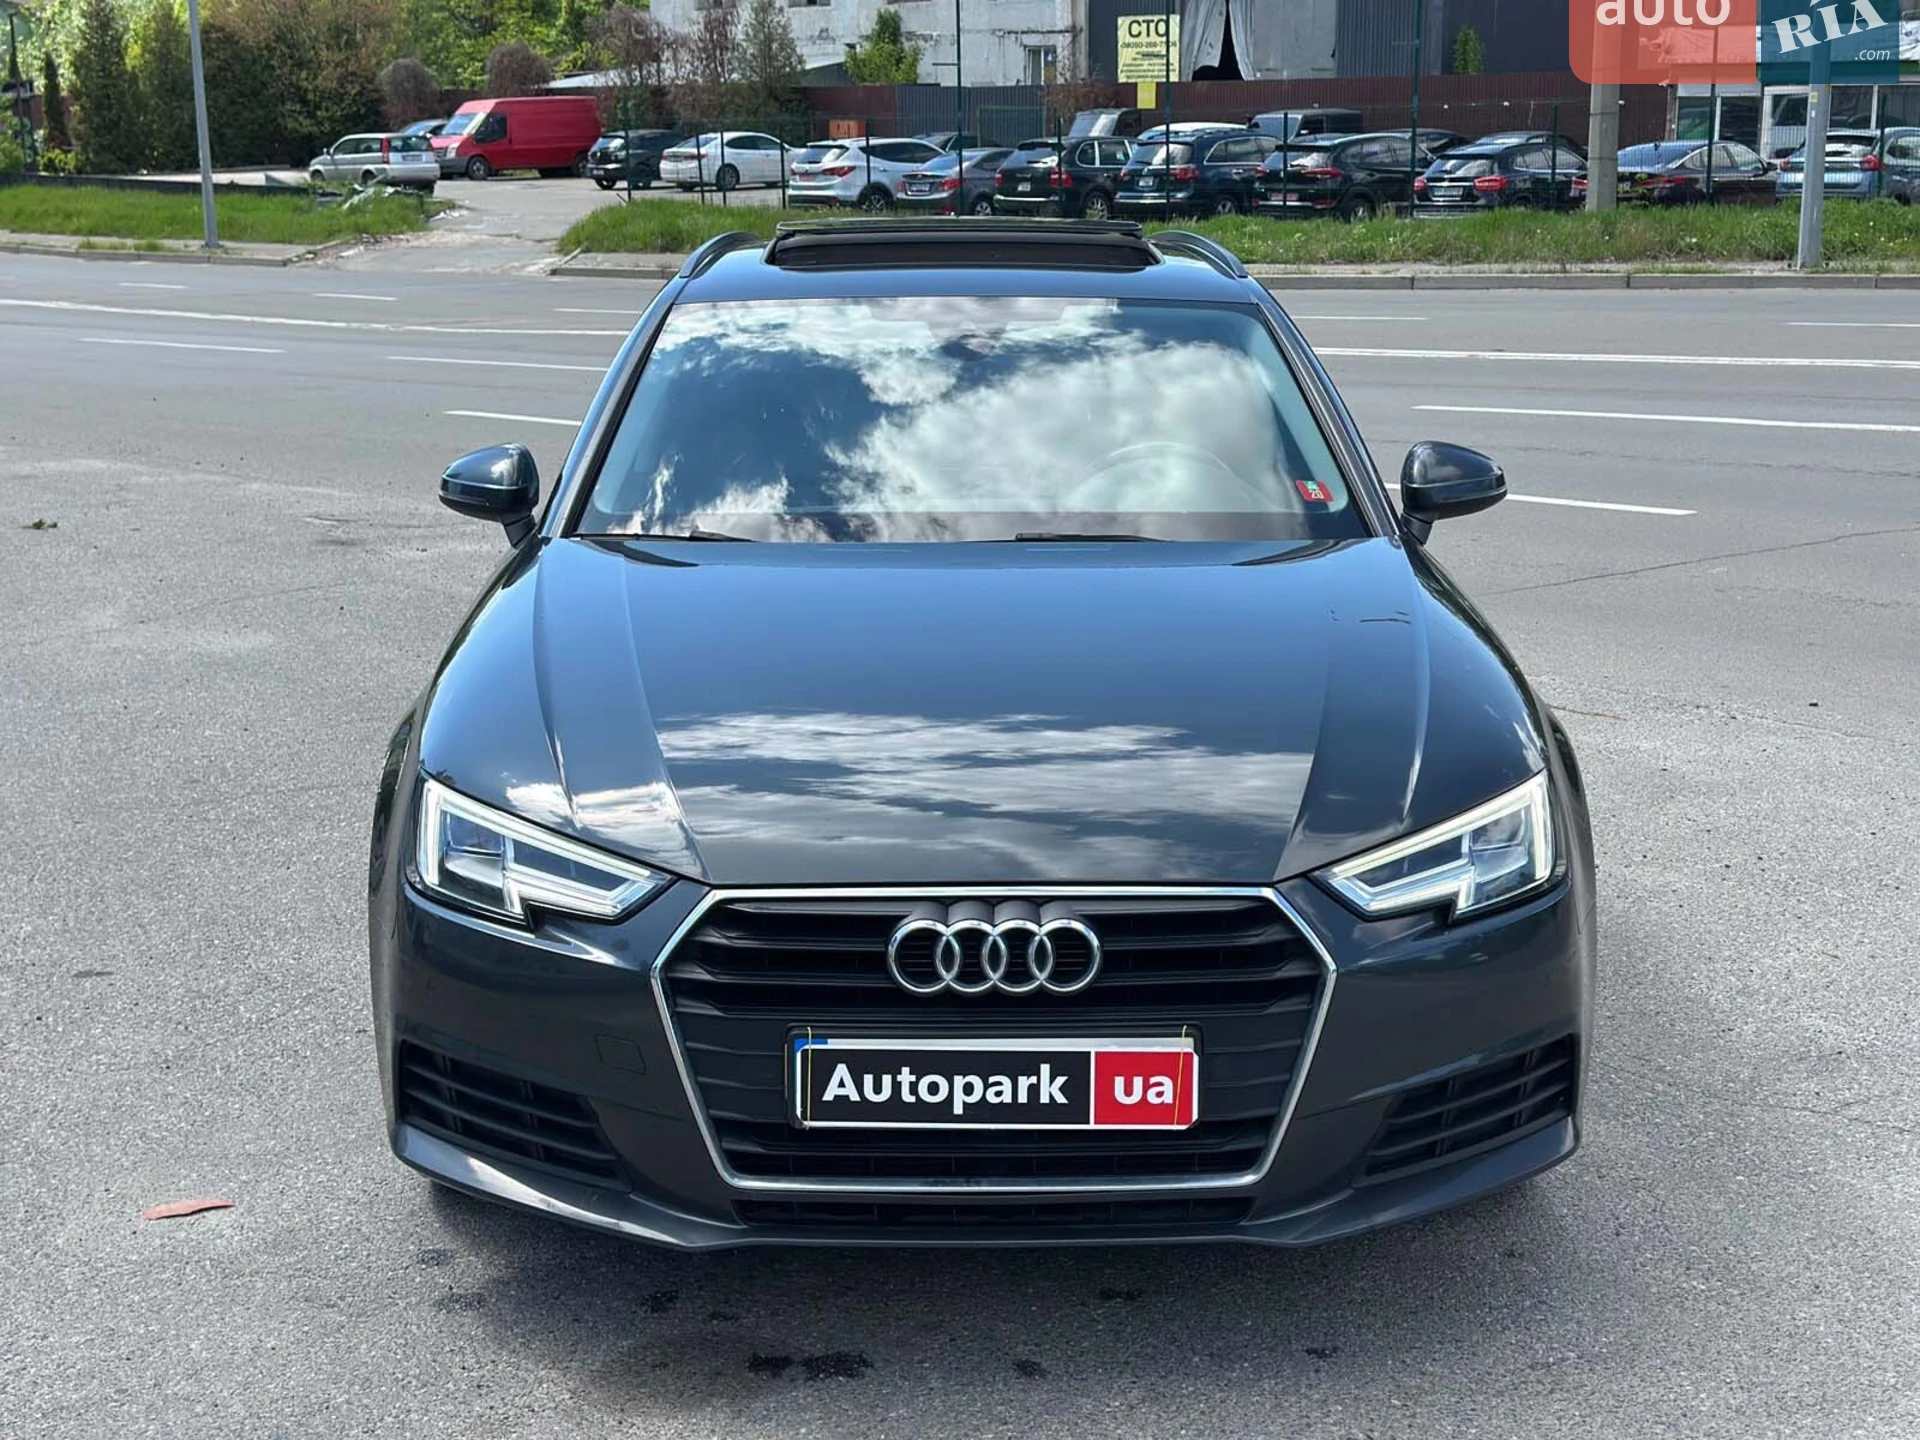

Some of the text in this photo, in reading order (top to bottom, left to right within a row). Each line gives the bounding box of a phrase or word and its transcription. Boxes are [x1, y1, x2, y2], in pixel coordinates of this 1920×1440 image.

[1128, 18, 1169, 38] СТО
[821, 1063, 1174, 1115] Autopark ua
